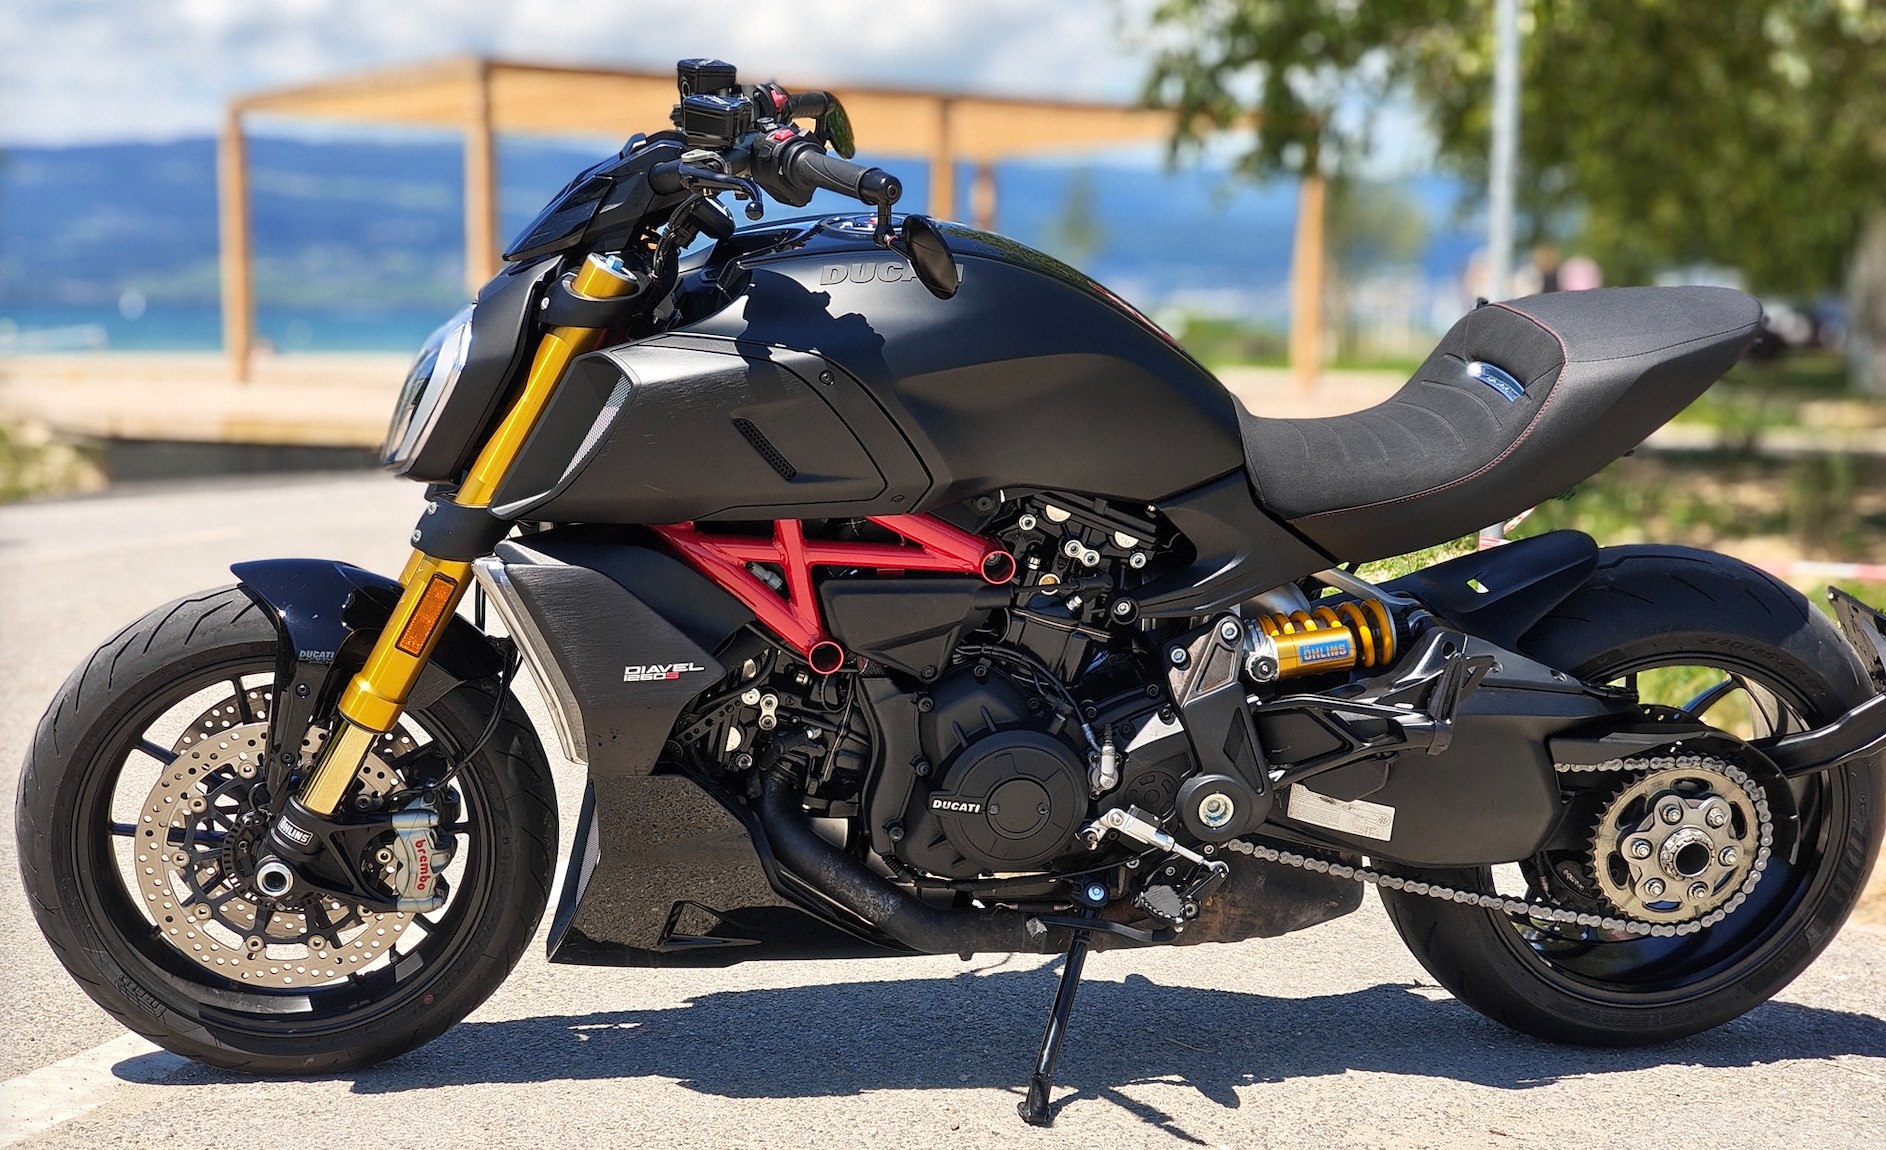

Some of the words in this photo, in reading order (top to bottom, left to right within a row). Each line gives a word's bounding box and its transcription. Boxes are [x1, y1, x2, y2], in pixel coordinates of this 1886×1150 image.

[820, 261, 965, 286] DUCI
[299, 649, 335, 658] DUCATI
[1304, 643, 1347, 661] ÖHLINS
[624, 662, 705, 675] DIAVEL
[623, 671, 680, 682] 1260S
[932, 799, 981, 813] DUCATI
[414, 839, 431, 891] brembo
